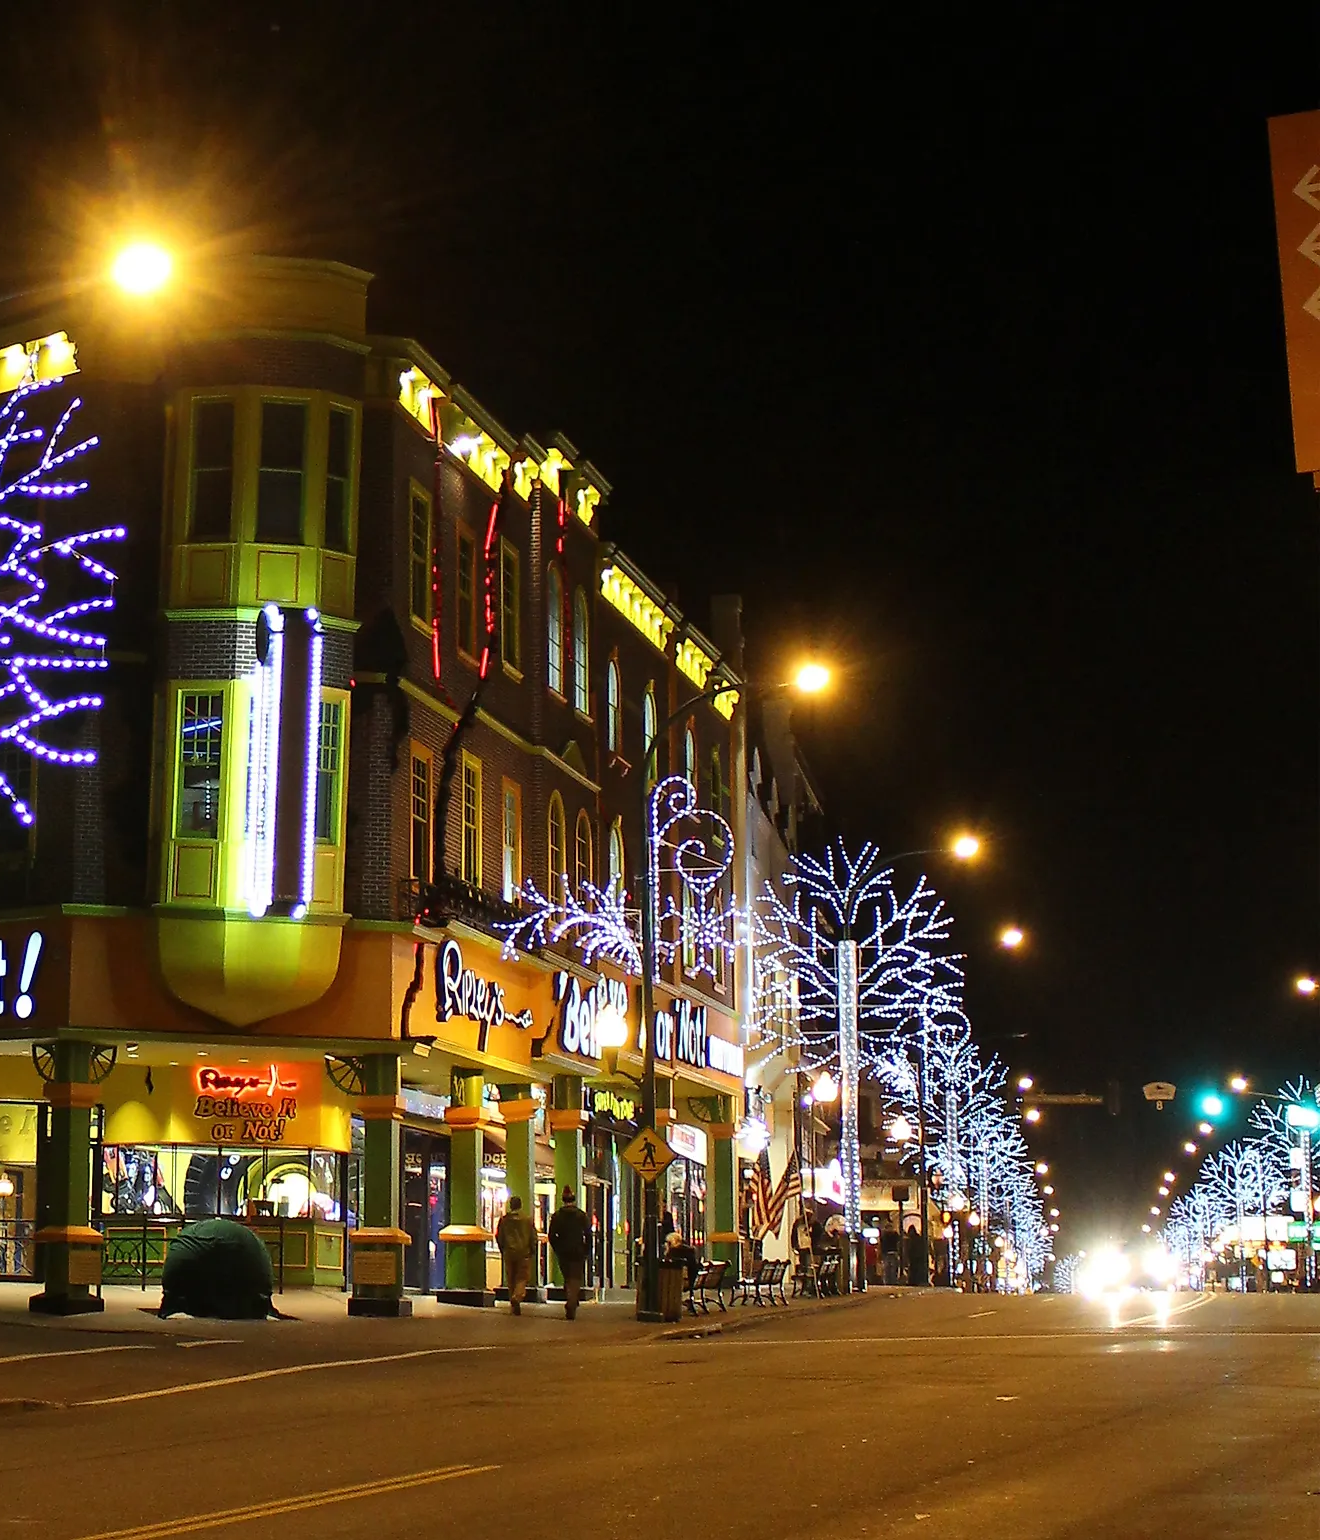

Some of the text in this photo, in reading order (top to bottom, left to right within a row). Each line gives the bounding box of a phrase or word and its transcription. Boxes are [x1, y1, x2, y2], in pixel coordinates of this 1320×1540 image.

[440, 940, 507, 1053] Ripley's
[656, 1010, 674, 1061] or
[194, 1095, 297, 1119] Believe It
[211, 1119, 286, 1141] or Not!
